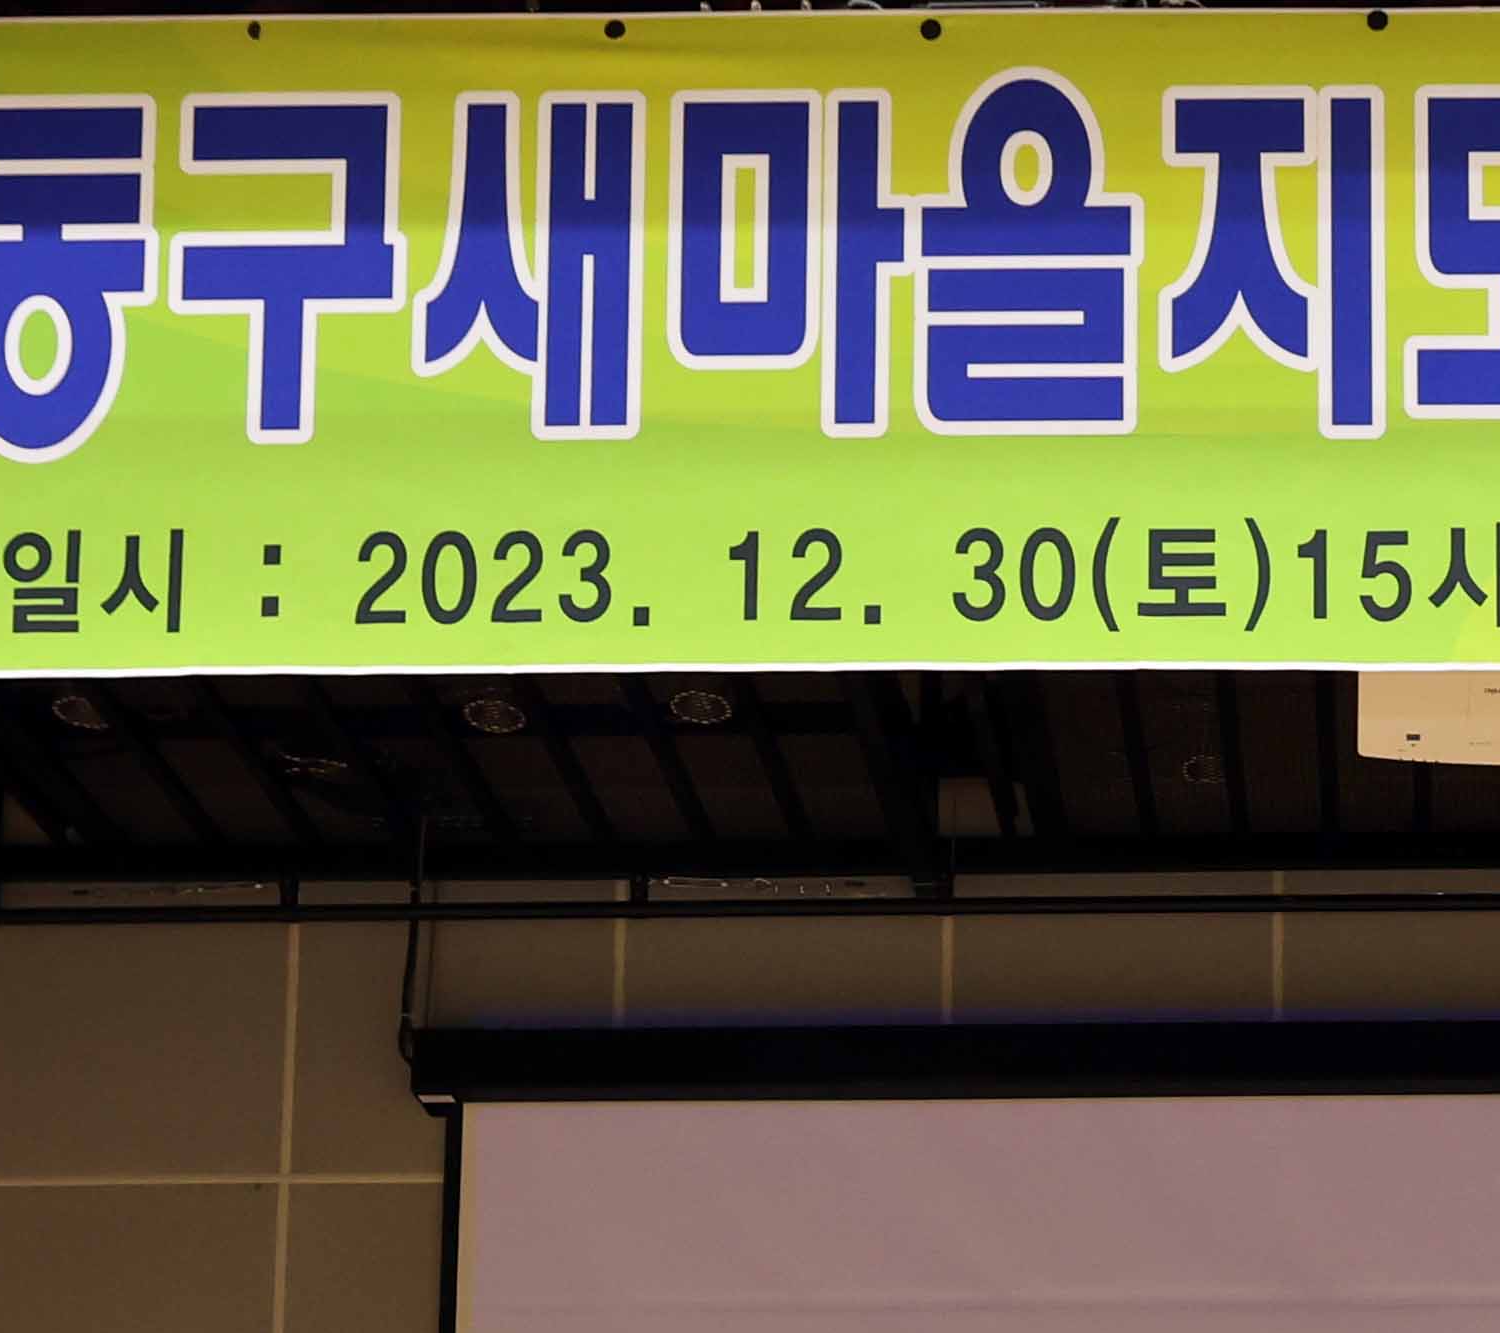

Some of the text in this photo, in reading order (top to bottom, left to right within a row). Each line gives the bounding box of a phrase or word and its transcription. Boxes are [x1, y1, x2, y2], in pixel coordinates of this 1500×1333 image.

[1, 527, 186, 634] 일시
[353, 528, 650, 627] 2023.
[727, 526, 882, 625] 12.
